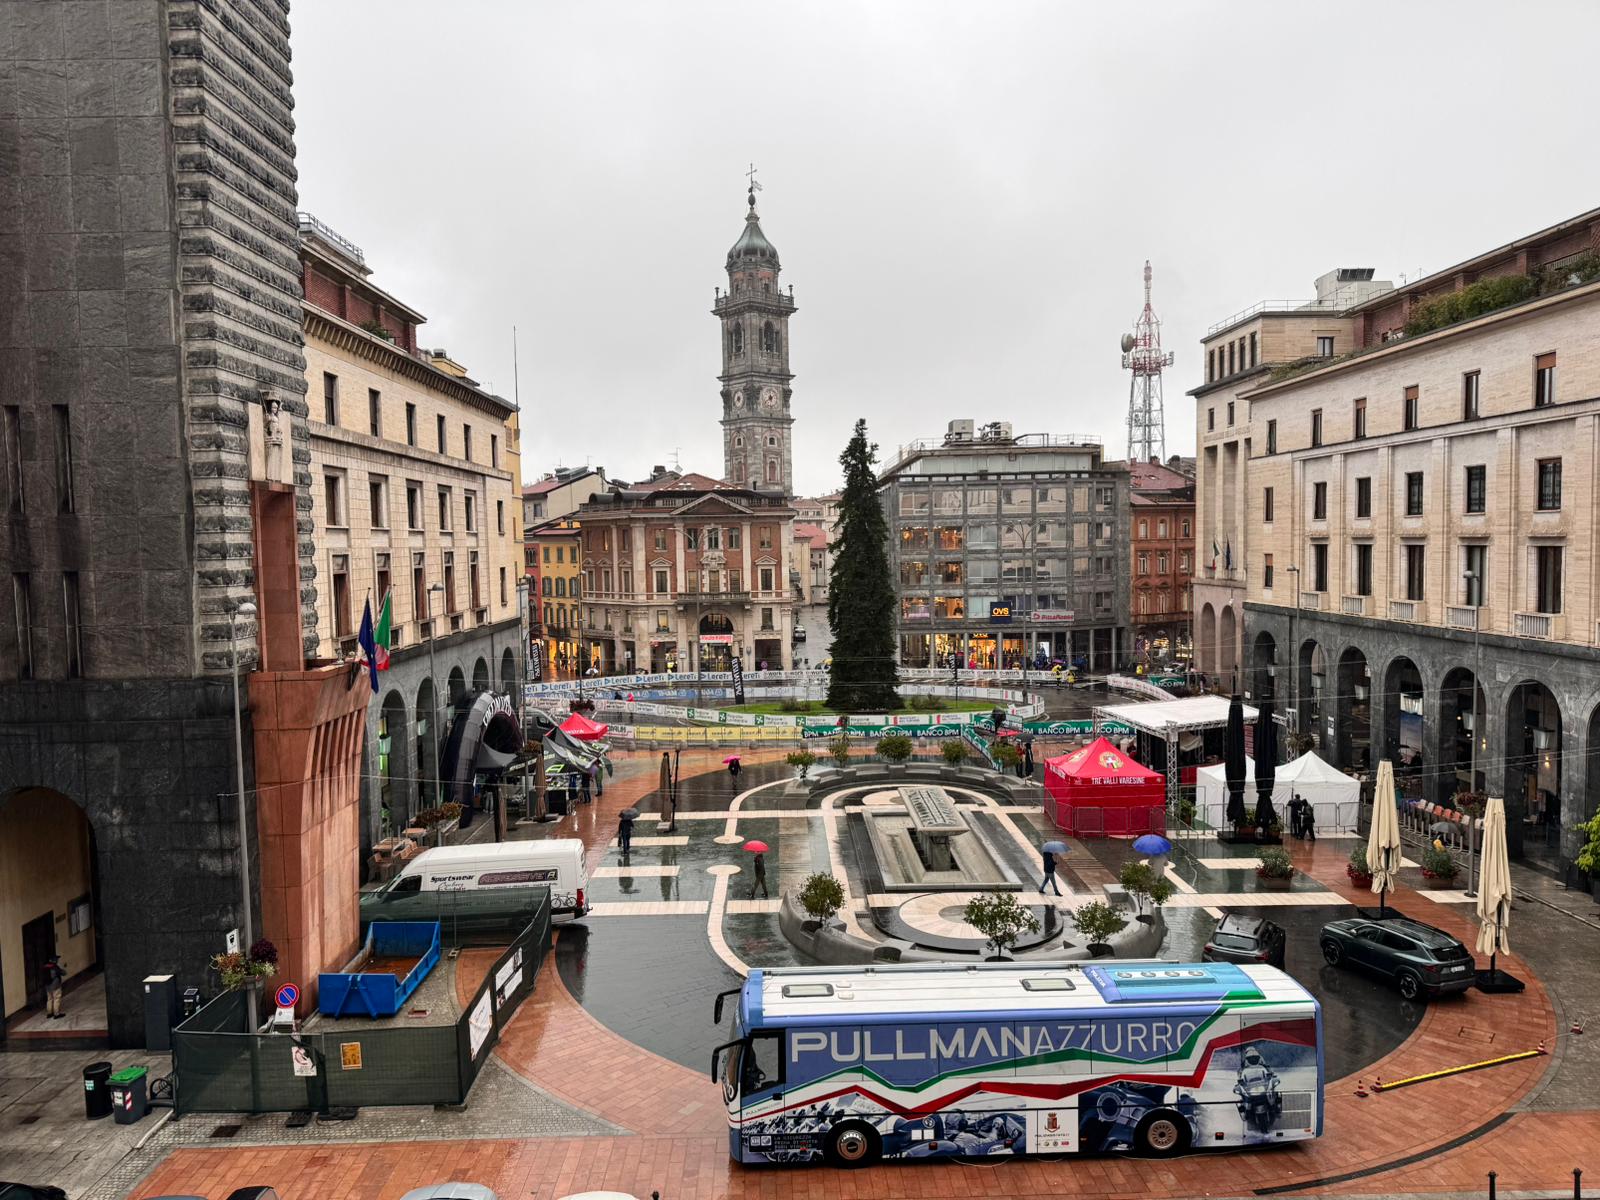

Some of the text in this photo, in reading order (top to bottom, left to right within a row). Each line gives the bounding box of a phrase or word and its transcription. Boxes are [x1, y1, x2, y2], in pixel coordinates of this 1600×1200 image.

[992, 607, 1009, 615] OVS
[611, 677, 633, 685] LereTi
[643, 675, 664, 683] LereTi
[675, 673, 697, 681] LereTi
[525, 685, 538, 693] eTi
[549, 683, 572, 691] LereTi
[823, 729, 849, 737] BAN
[869, 729, 896, 737] BANCO
[917, 729, 943, 737] BANCO
[1038, 726, 1081, 734] BANCO BPM
[1113, 726, 1129, 734] BPM
[1091, 776, 1145, 785] TRE VALLI VARESINE
[430, 875, 475, 883] Sportswear
